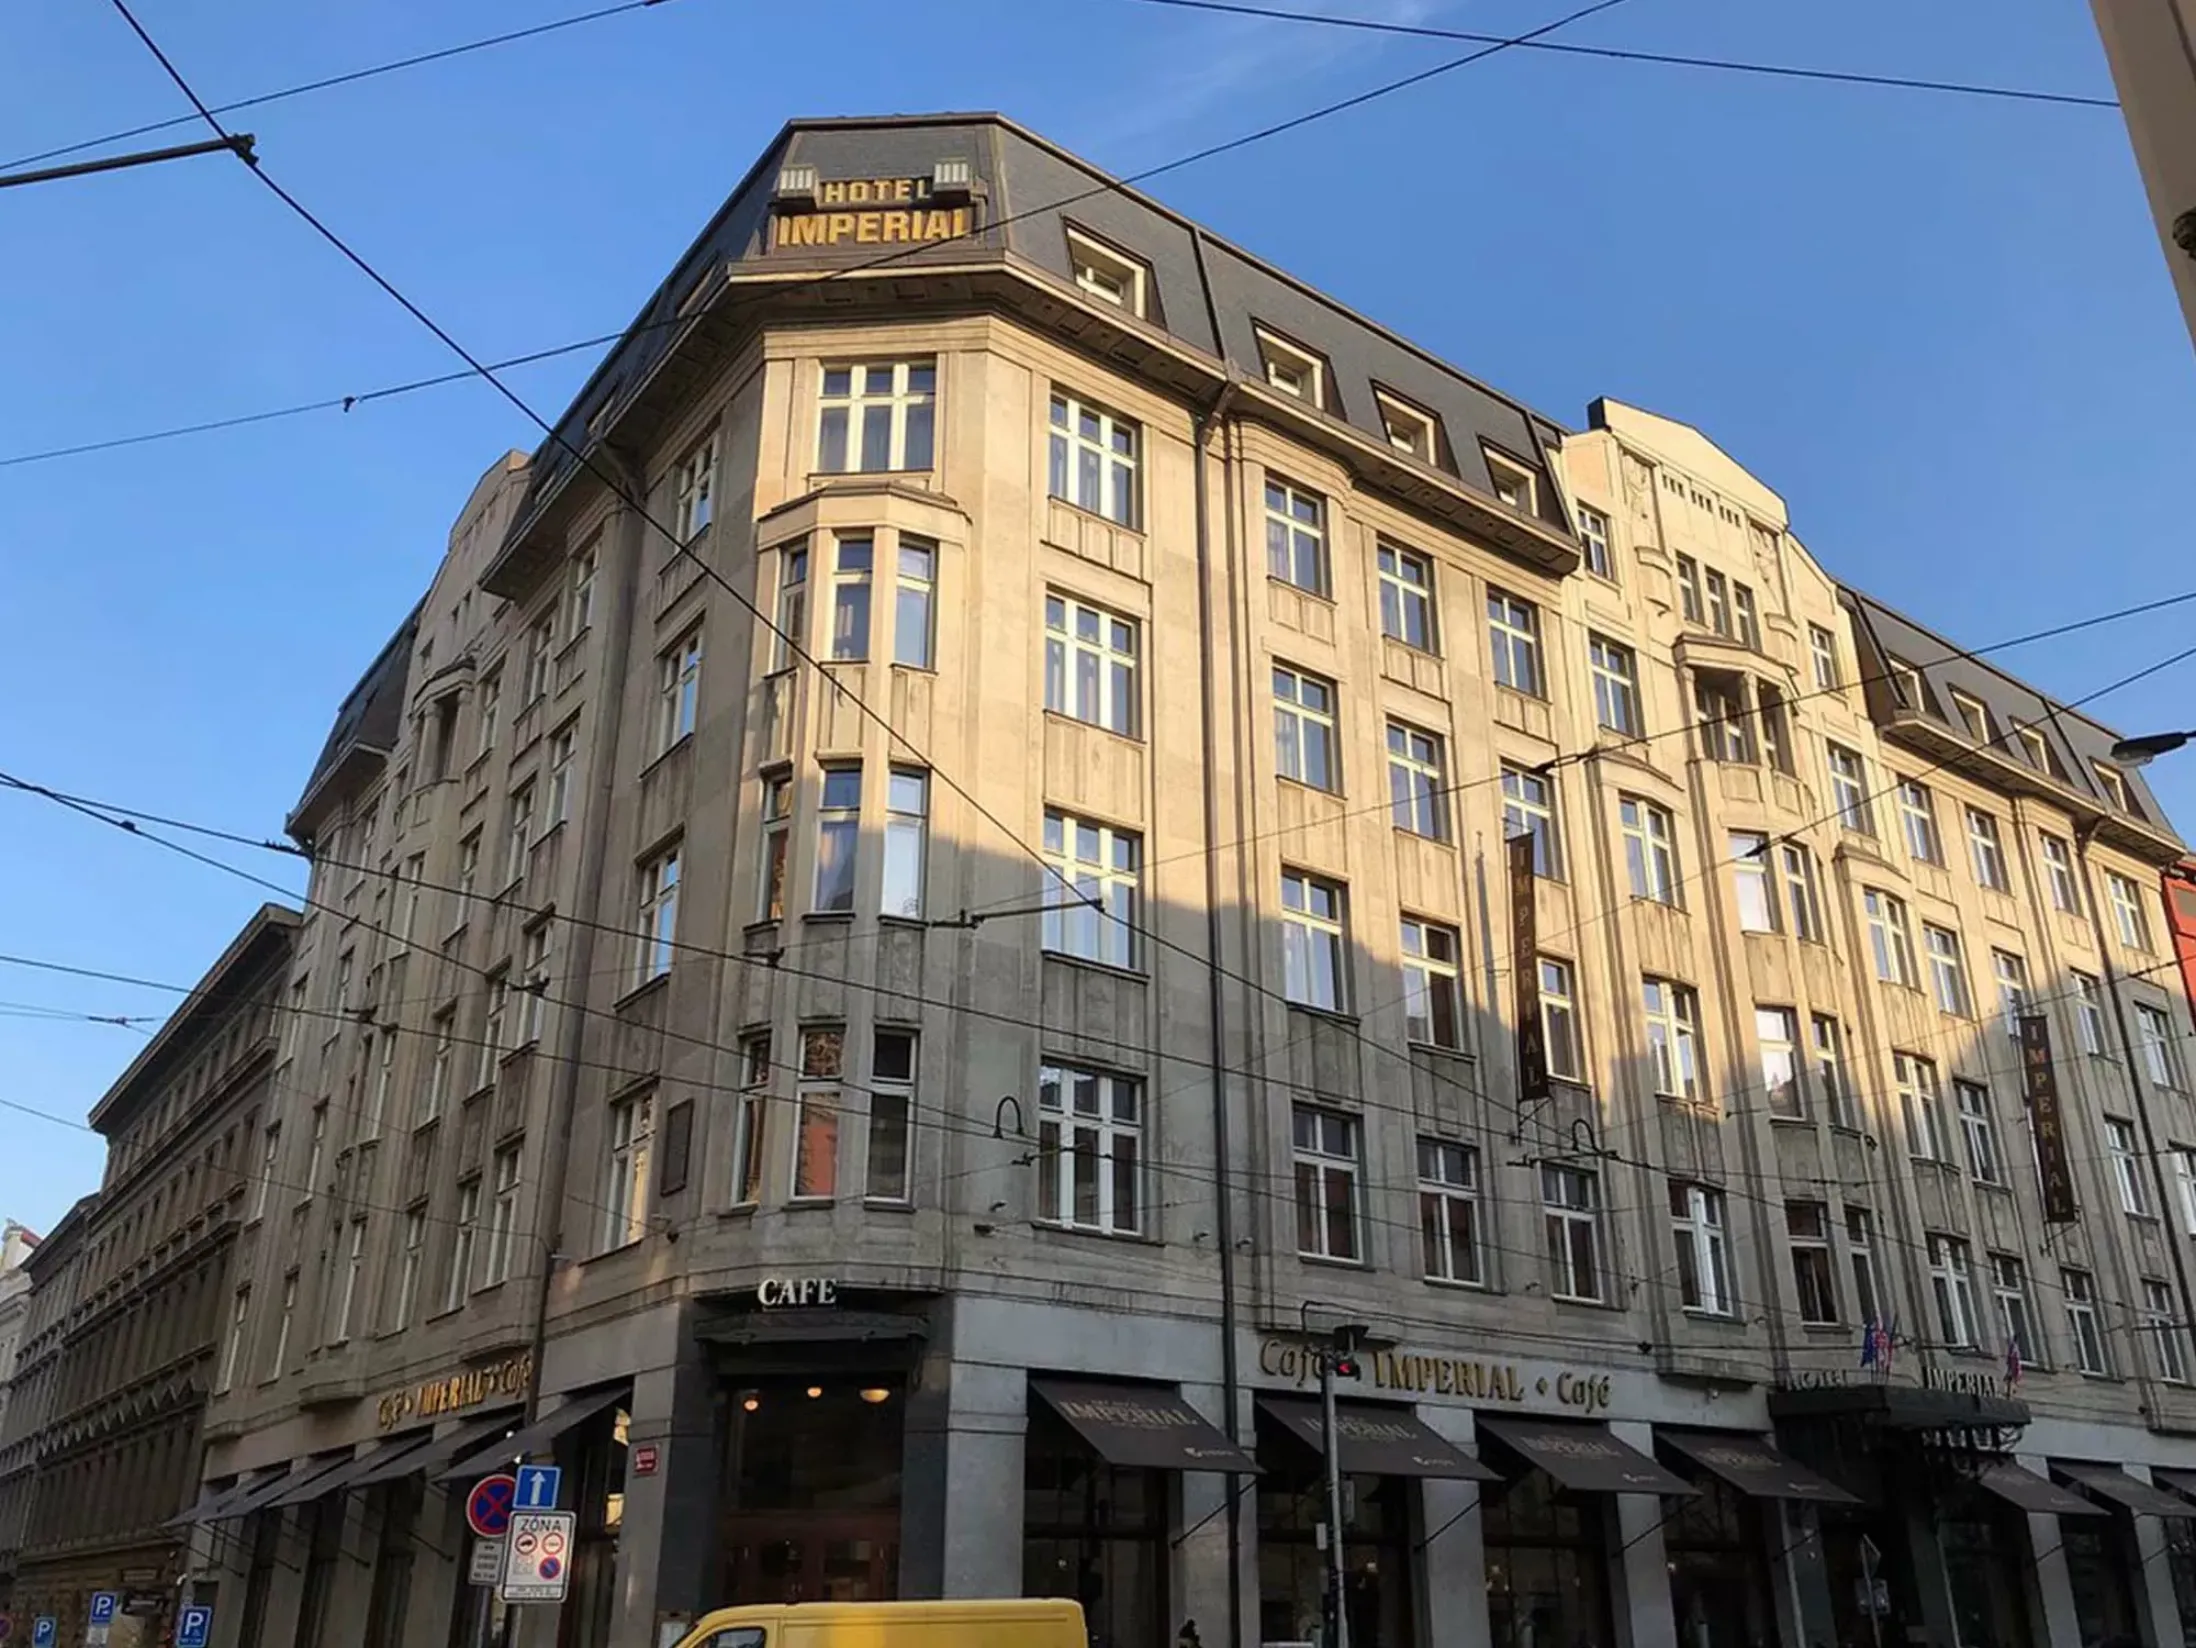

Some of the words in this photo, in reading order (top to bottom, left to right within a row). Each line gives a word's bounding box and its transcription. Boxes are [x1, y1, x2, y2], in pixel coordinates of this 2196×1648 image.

[825, 178, 932, 203] HOTEL
[777, 207, 972, 247] IMPERIAL
[1516, 846, 1540, 1086] IMPERIAL
[2028, 1025, 2067, 1214] IMPERIAL
[757, 1278, 837, 1306] CAFE
[1370, 1351, 1523, 1402] IMPERIAL
[1556, 1371, 1612, 1415] Café
[1059, 1402, 1199, 1426] IMPERIAL
[185, 1612, 204, 1636] P
